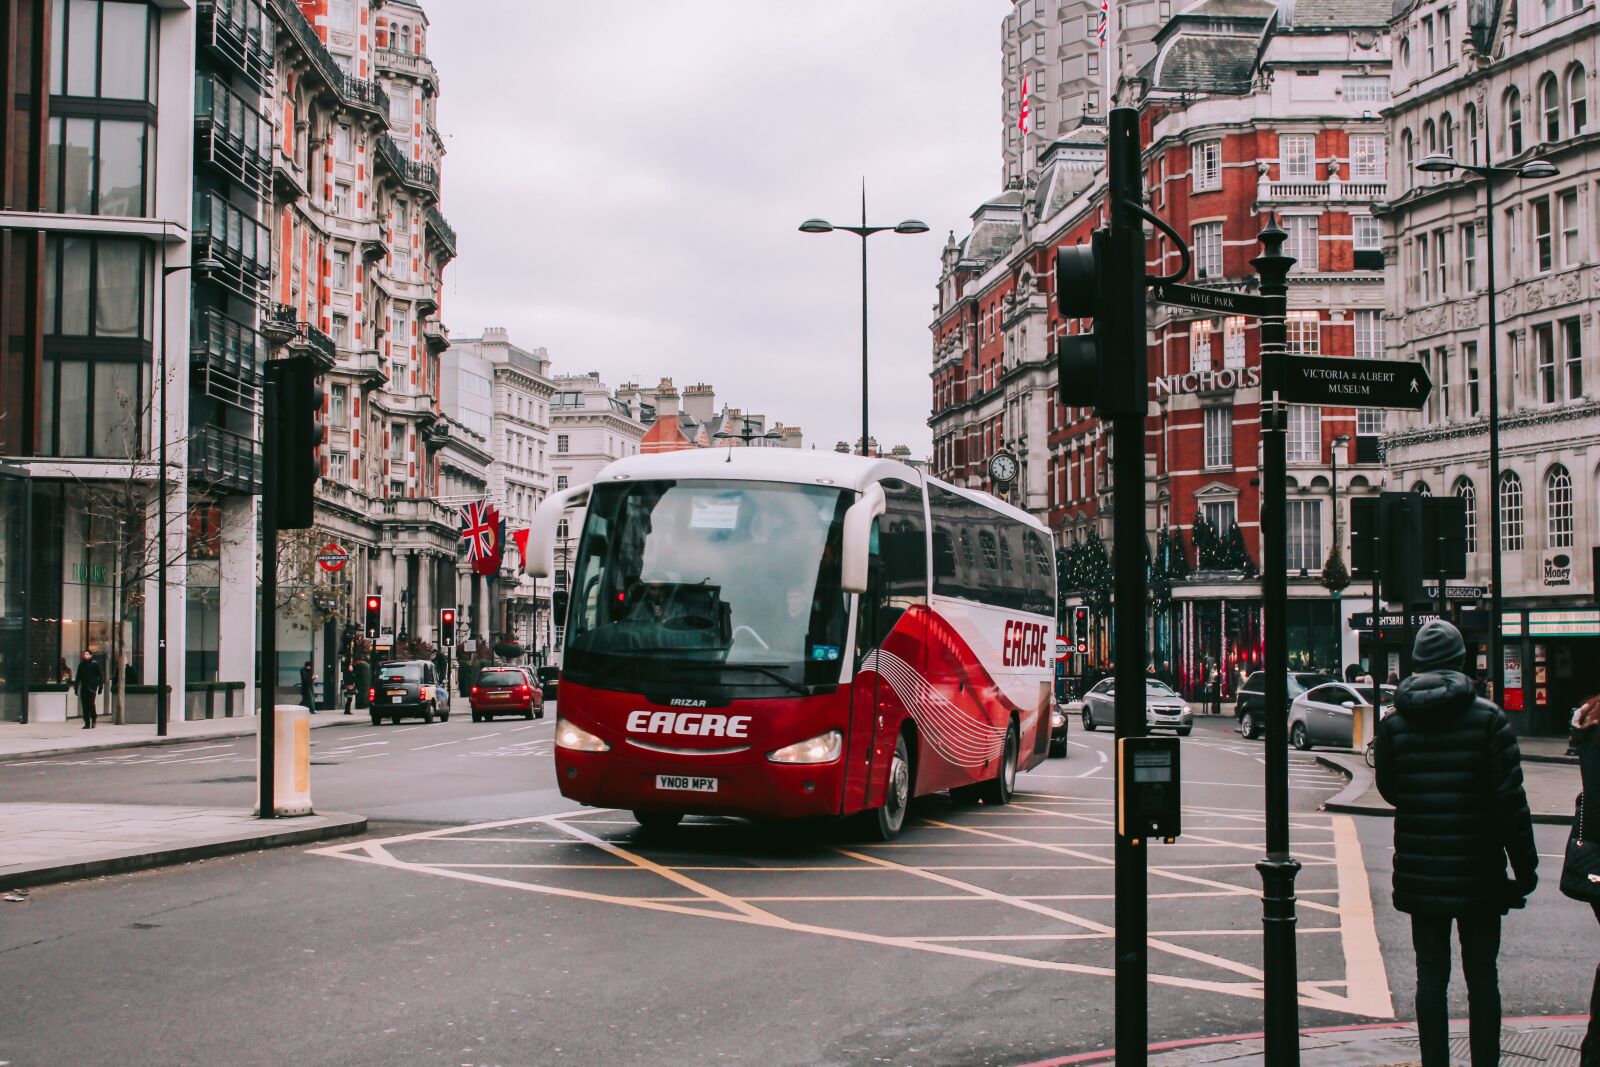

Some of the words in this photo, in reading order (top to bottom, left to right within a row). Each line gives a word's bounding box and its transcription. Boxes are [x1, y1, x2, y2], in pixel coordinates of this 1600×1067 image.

[1190, 292, 1211, 305] HYDE
[1214, 296, 1234, 308] PARK
[1155, 367, 1260, 396] NICHOLS
[1303, 369, 1349, 380] VICTORIA
[1359, 372, 1395, 382] ALBERT
[1328, 384, 1370, 394] MUSEUM
[1544, 558, 1552, 566] the
[1544, 566, 1570, 579] Money
[1428, 587, 1481, 598] UNERGROUND
[1003, 619, 1048, 668] EAGRE
[670, 698, 707, 707] IRIZAR
[626, 710, 752, 738] EAGRE
[660, 776, 688, 789] YN08
[691, 779, 714, 790] MPX
